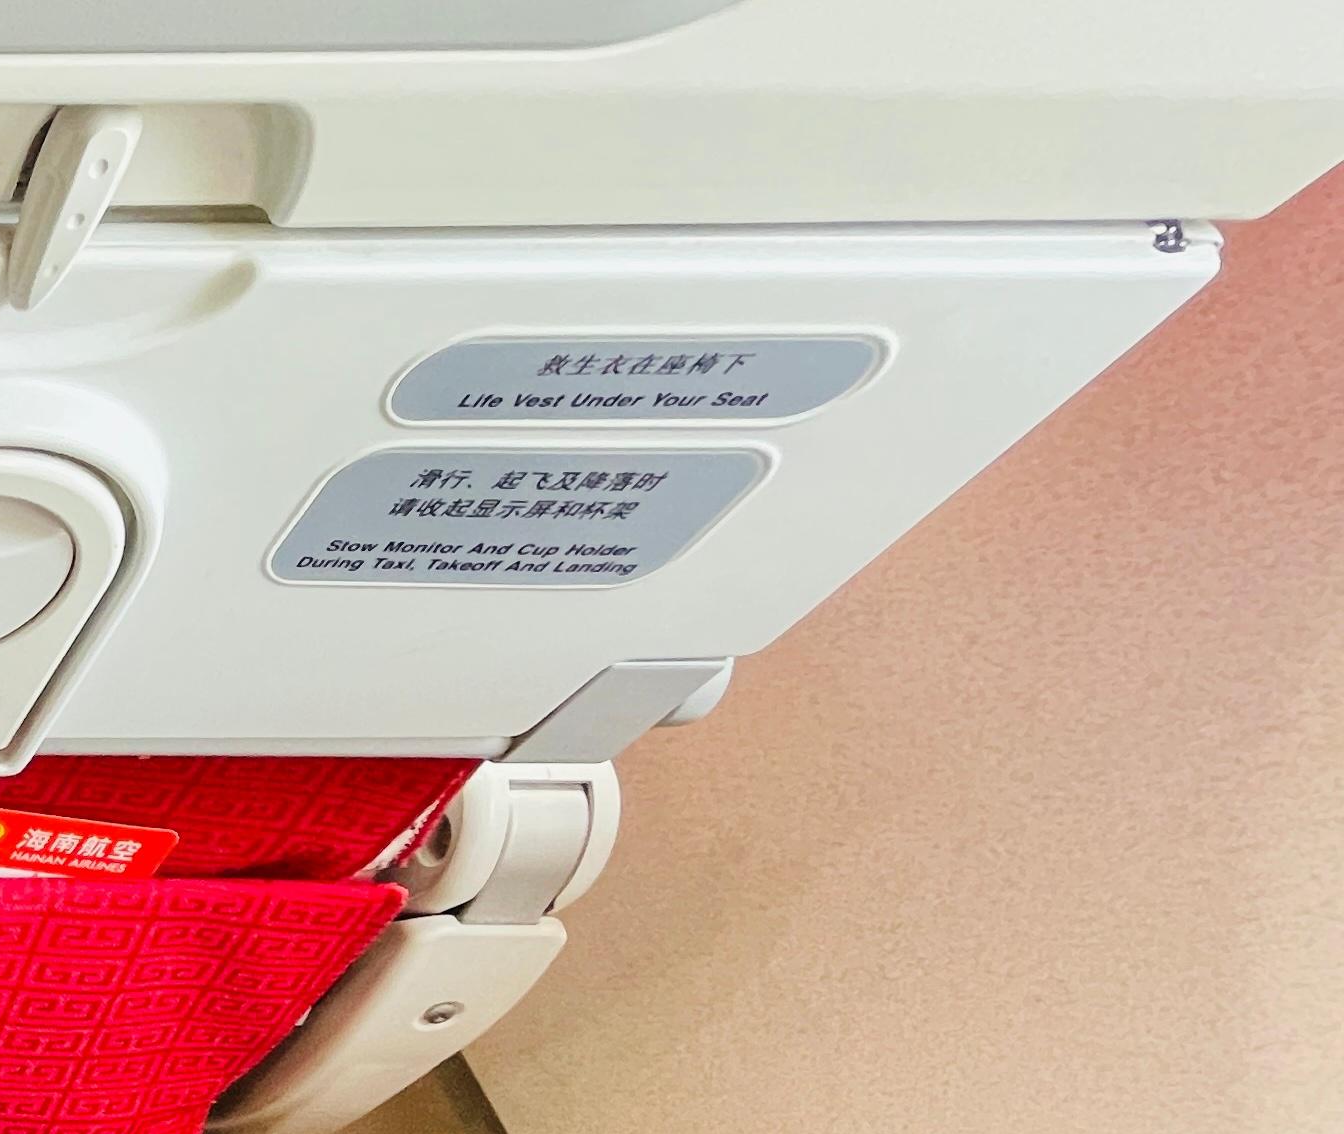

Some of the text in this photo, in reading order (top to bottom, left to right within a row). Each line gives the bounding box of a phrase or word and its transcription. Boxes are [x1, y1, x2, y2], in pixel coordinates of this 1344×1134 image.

[537, 352, 757, 376] 救生衣在座椅下
[458, 391, 769, 408] Life Vest Under Your Seat
[389, 498, 640, 520] 请收起显示屏和杯架
[326, 539, 637, 558] Stow Monitor And Cup Holder
[296, 557, 365, 572] During
[427, 559, 500, 572] Takeoff
[502, 560, 547, 573] And
[552, 561, 638, 576] Landing
[15, 828, 142, 862] 海南航空
[10, 850, 127, 874] HAINAN AIRLINES
